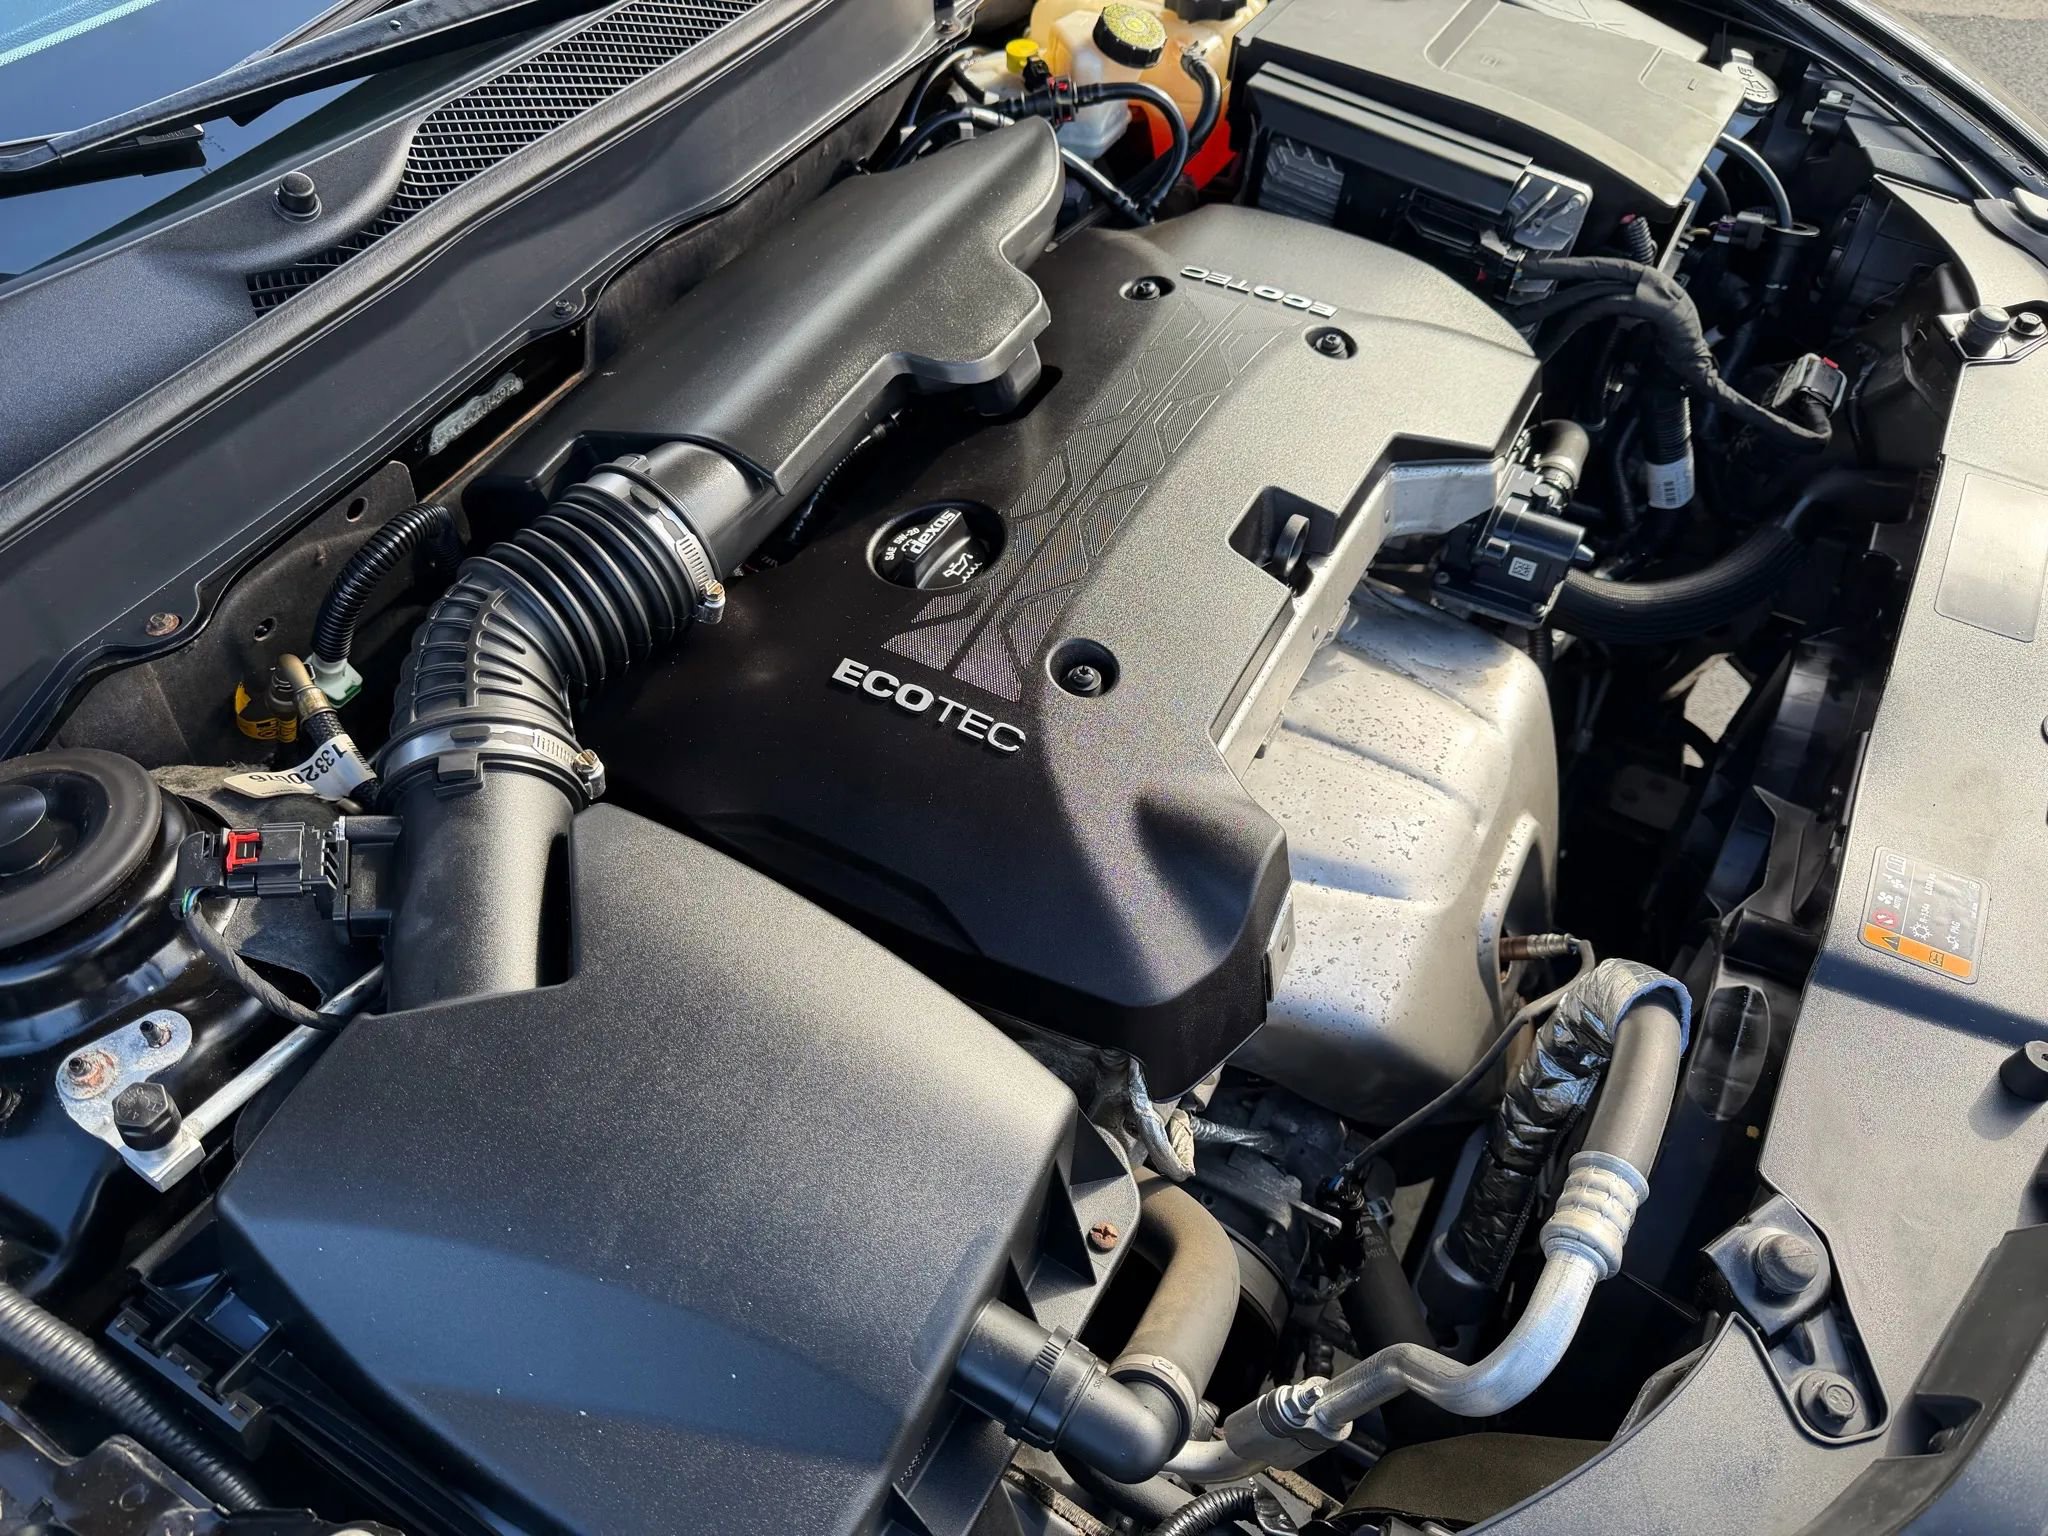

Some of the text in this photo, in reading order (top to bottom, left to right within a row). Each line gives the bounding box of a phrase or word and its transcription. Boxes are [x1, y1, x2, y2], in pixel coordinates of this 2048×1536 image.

[1180, 264, 1338, 318] ECOTEC
[884, 546, 897, 561] SAE
[908, 511, 957, 554] dexos
[832, 657, 1026, 752] ECOTEC
[1950, 920, 1961, 935] PAG
